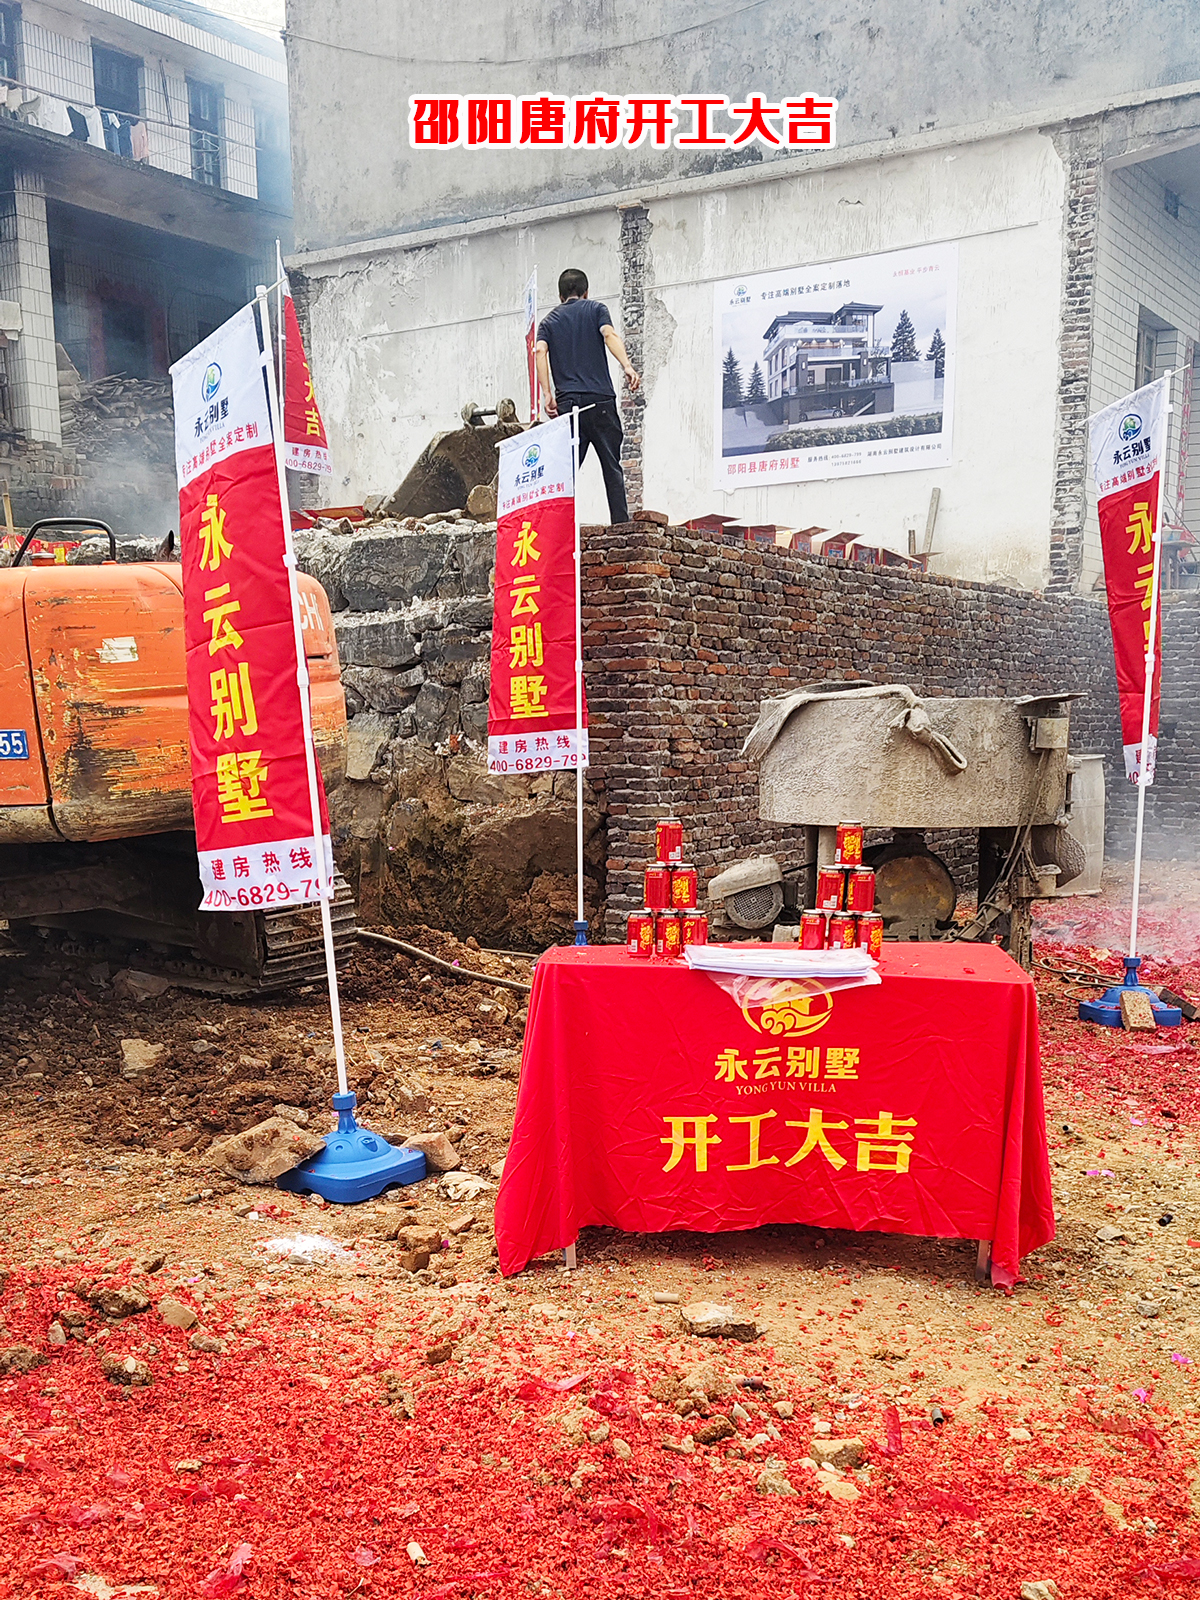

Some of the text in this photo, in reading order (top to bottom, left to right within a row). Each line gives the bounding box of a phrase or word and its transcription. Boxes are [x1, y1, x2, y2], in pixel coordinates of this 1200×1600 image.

[760, 279, 851, 300] 专注高端别墅全案定制落地
[727, 457, 800, 475] 邵阳县唐府别墅
[1112, 436, 1152, 465] 永云别墅
[509, 521, 549, 719] 永云别墅
[199, 494, 274, 824] 永云别墅
[499, 734, 571, 755] 建房热线
[210, 846, 314, 881] 建房热线
[714, 1046, 861, 1083] 永云别墅
[735, 1080, 837, 1096] YONG YUN VILLA
[659, 1107, 919, 1174] 开工大吉
